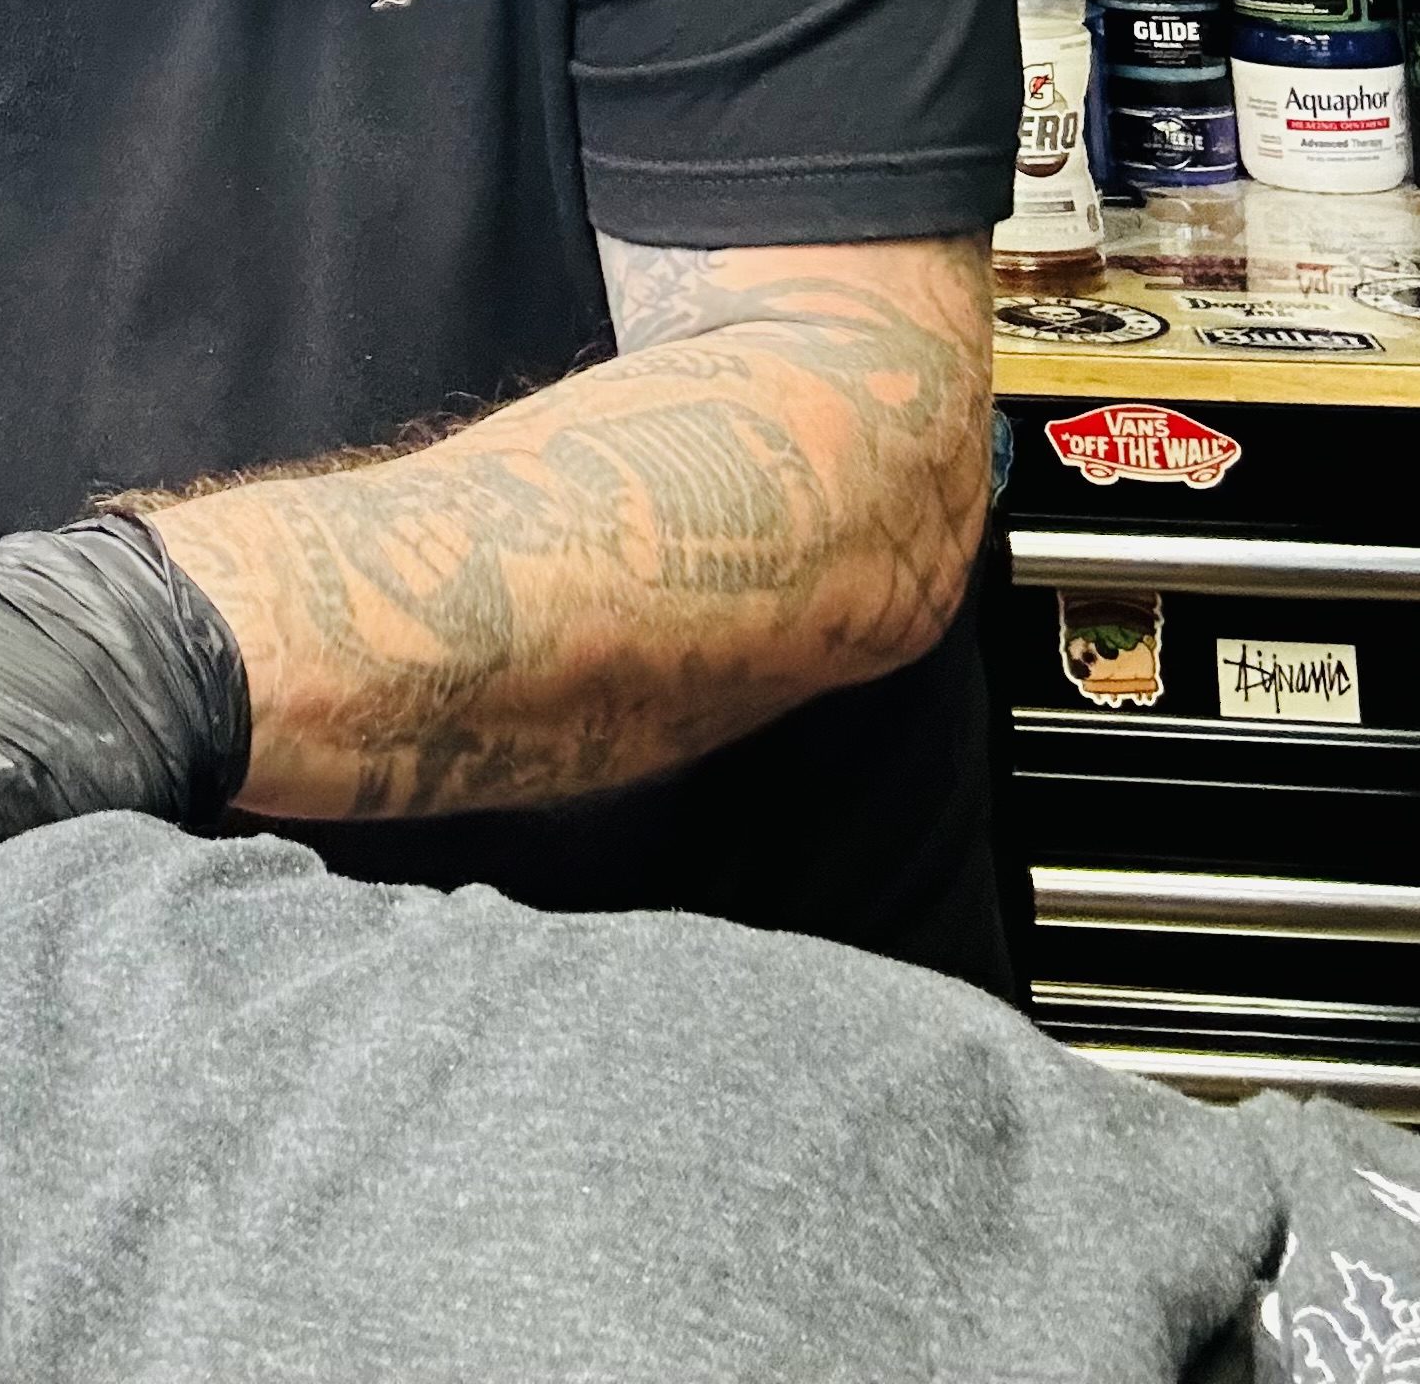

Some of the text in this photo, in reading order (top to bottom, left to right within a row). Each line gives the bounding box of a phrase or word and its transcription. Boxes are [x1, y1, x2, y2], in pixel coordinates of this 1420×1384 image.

[1133, 20, 1201, 42] GLIDE
[1285, 84, 1390, 119] Aquaphor
[1018, 110, 1079, 152] ERO
[1104, 411, 1171, 438] VANS
[1113, 435, 1163, 469] THE
